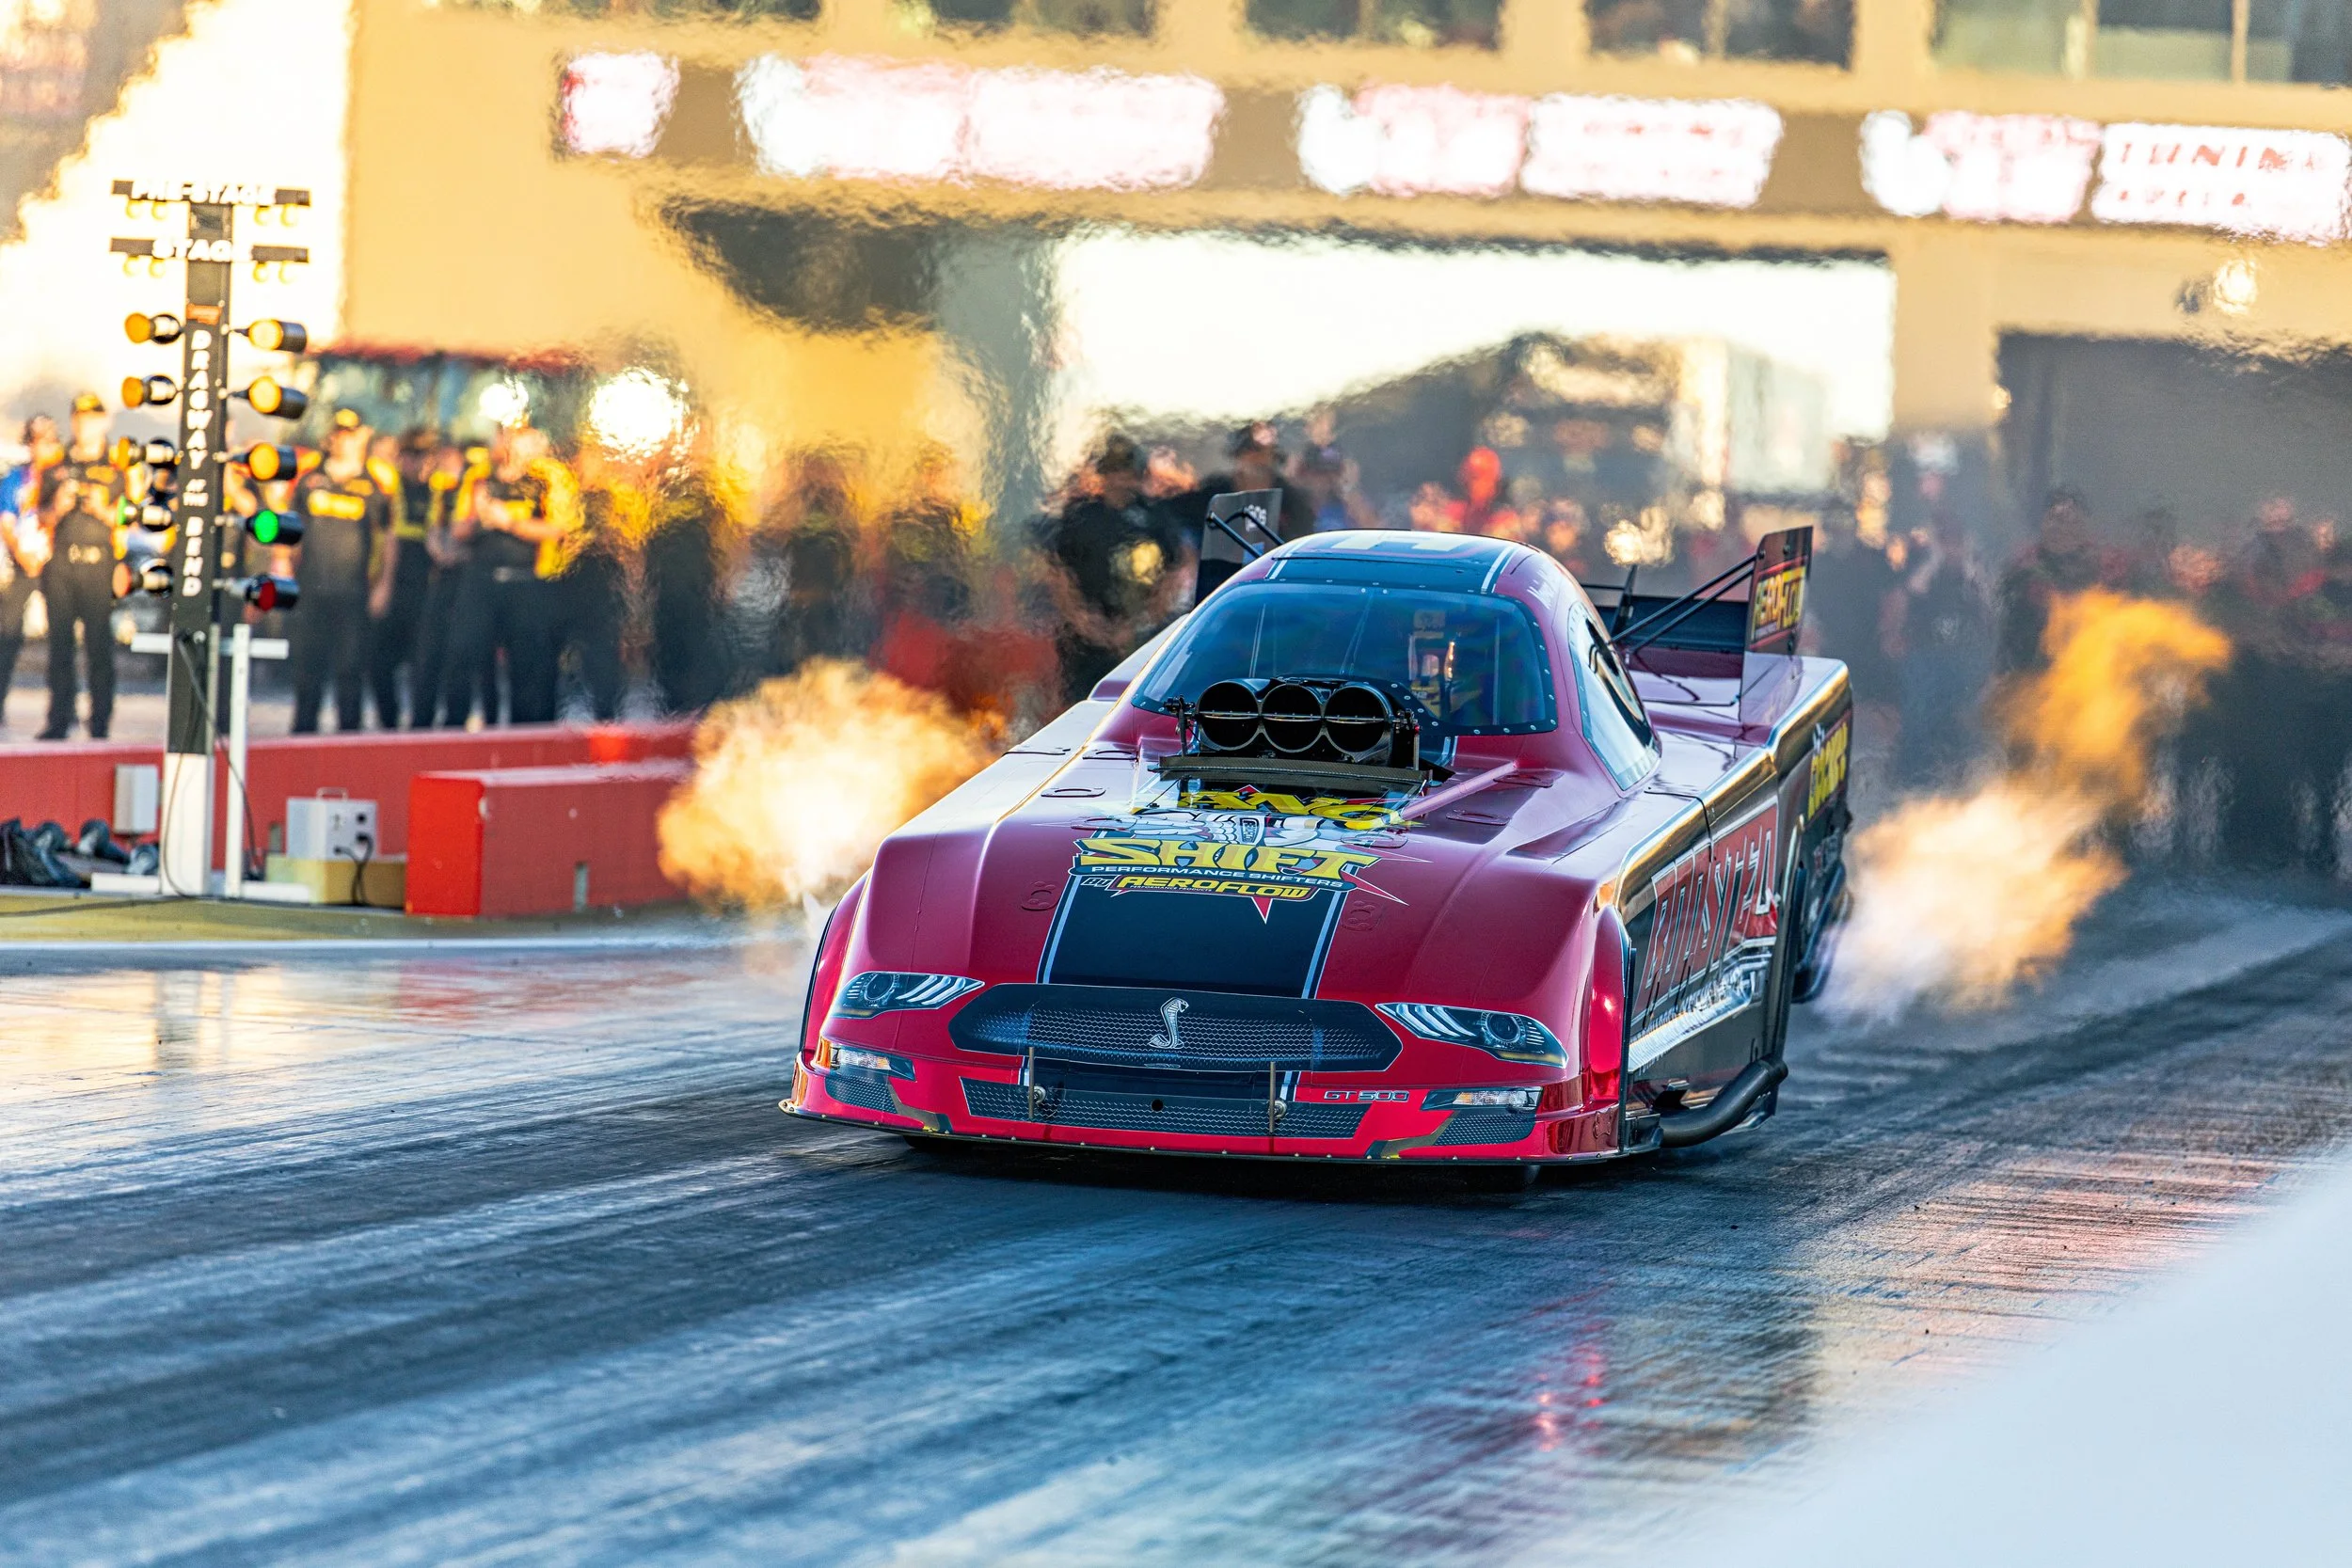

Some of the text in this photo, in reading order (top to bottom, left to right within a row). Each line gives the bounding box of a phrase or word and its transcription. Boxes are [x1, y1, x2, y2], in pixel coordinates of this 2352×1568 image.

[151, 236, 253, 264] STAGE
[184, 328, 214, 471] DRAGWAY
[182, 515, 204, 597] BEND
[1080, 837, 1381, 880] SHIFT
[1091, 865, 1344, 888] PERFORMANCE SHIFTERS
[1117, 876, 1312, 898] AEROFLOW
